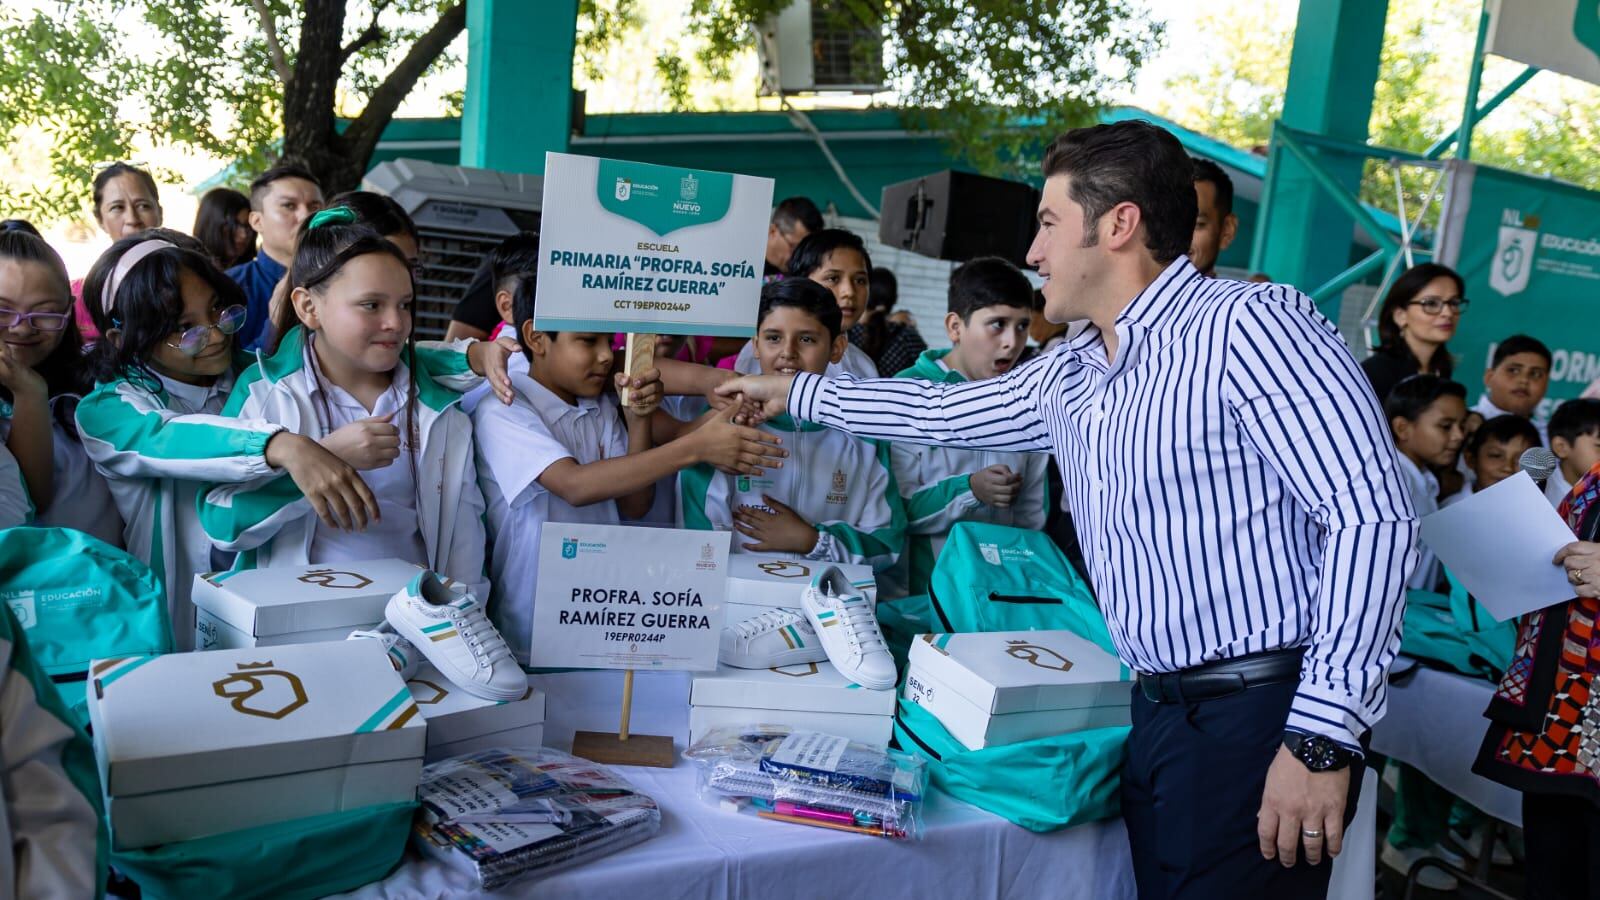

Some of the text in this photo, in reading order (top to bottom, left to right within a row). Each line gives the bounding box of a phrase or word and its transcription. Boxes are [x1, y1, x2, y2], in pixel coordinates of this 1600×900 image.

[673, 202, 701, 213] NUEVO
[1502, 209, 1523, 227] NL
[637, 242, 680, 253] ESCUELA
[1540, 232, 1600, 256] EDUCACIÓ
[550, 250, 632, 270] PRIMARIA
[711, 260, 755, 279] SOFÍA
[581, 272, 653, 292] RAMÍREZ
[614, 299, 631, 310] CCT
[41, 587, 101, 602] EDUCACIÓN
[571, 588, 703, 607] PROFRA. SOFÍA
[559, 607, 711, 630] RAMÍREZ GUERRA
[604, 631, 666, 644] 19EPR0244P
[909, 676, 925, 696] SENL
